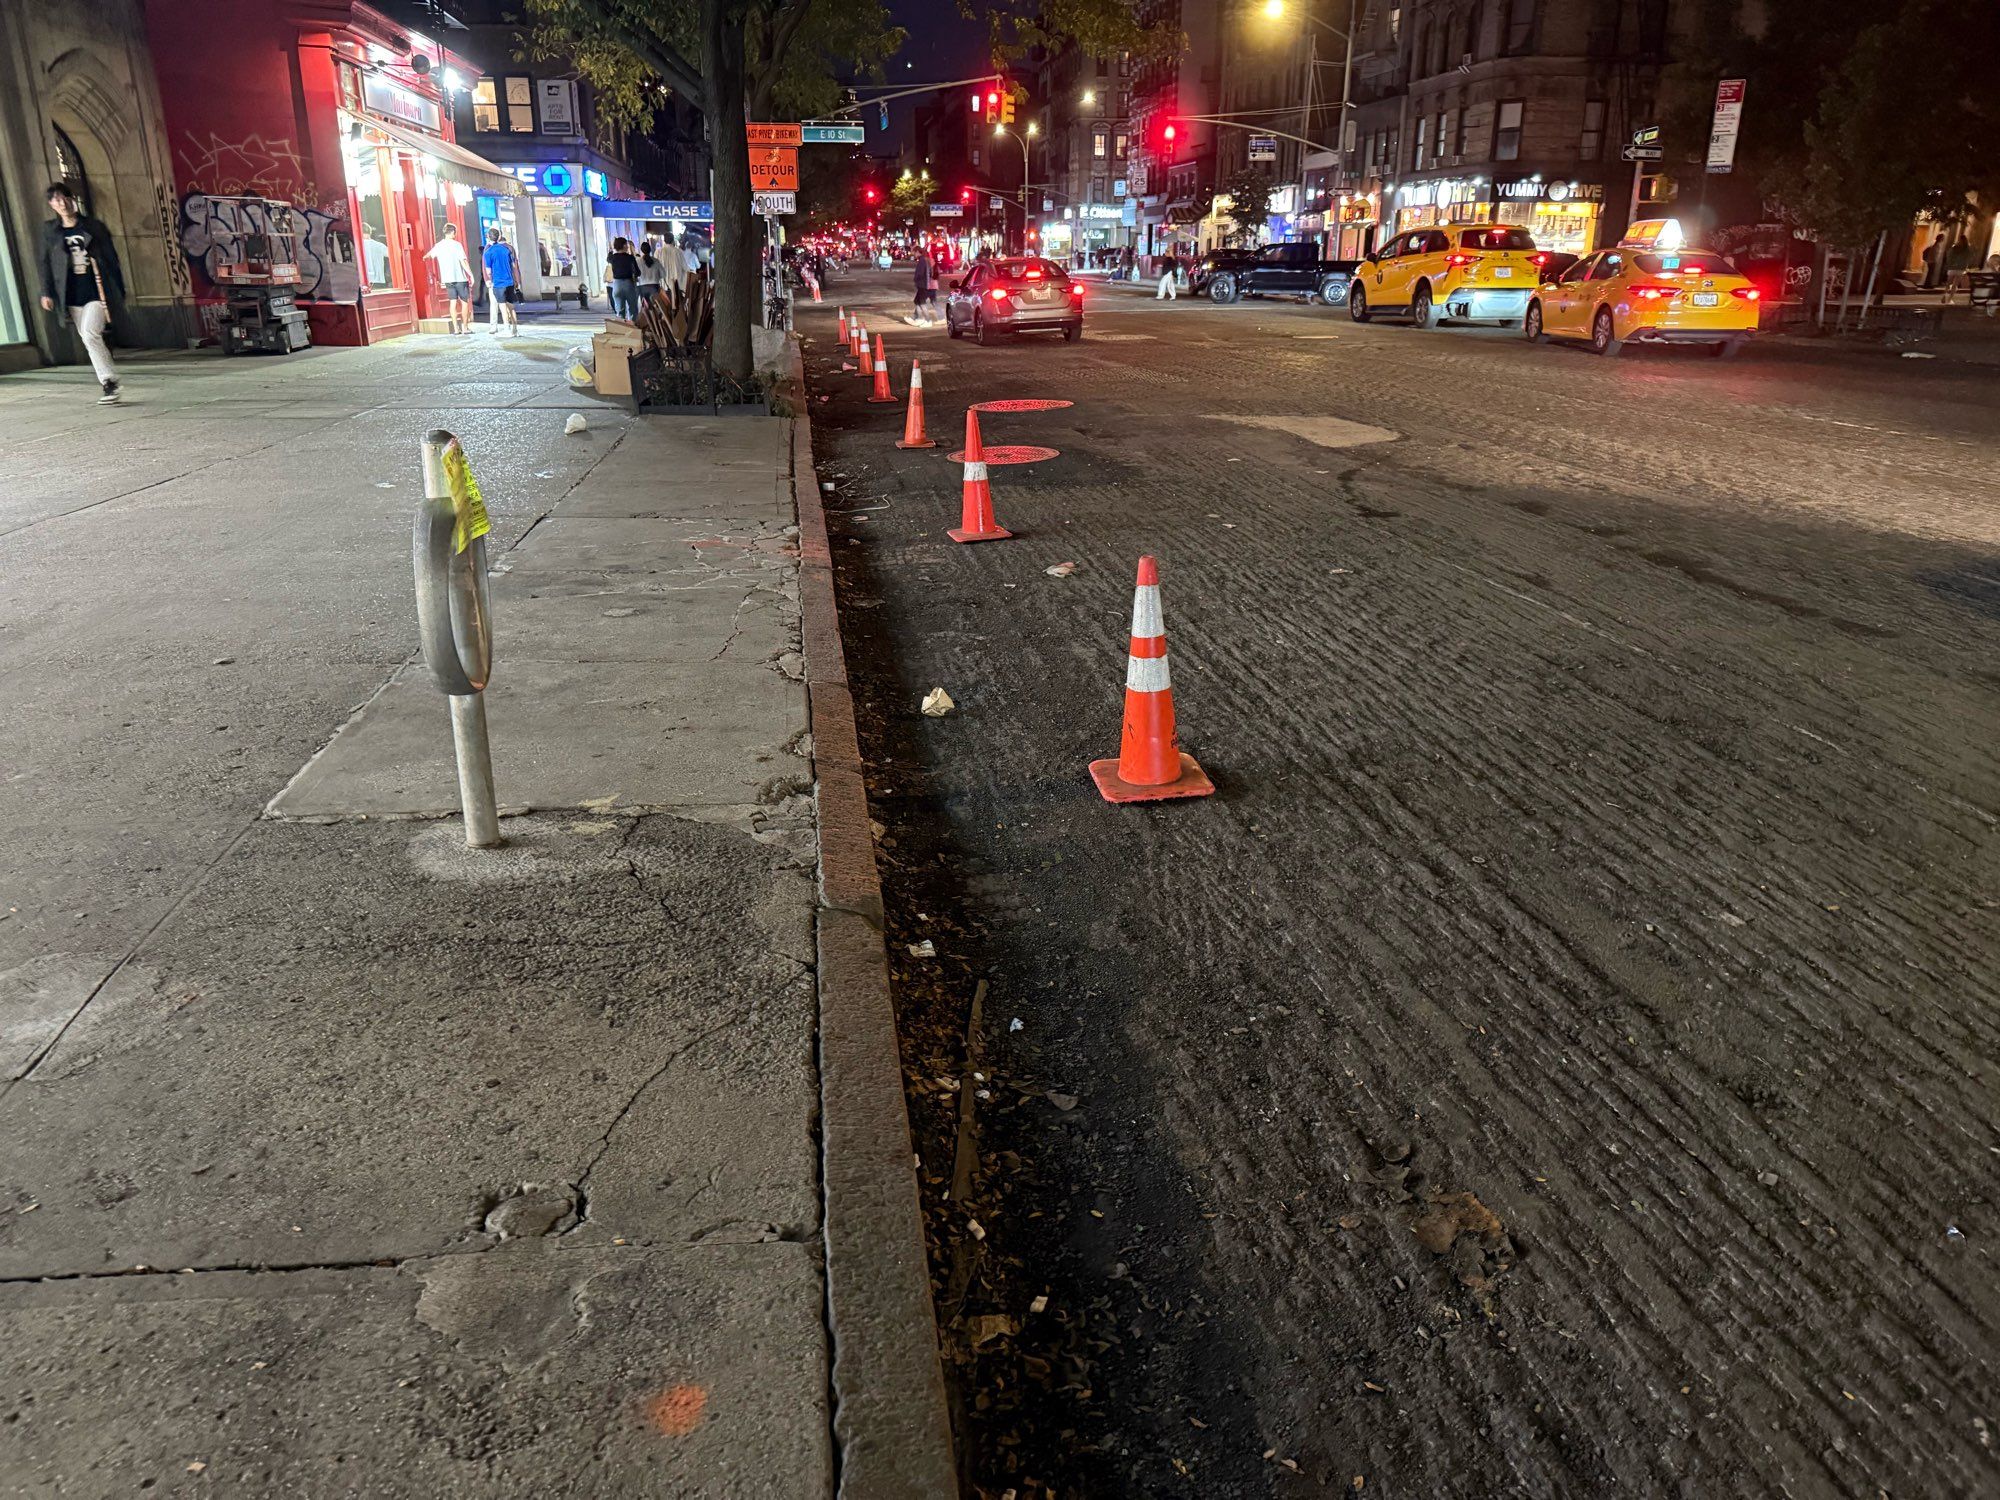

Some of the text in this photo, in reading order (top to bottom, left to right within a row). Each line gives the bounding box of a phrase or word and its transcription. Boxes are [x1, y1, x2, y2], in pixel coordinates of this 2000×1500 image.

[748, 128, 757, 139] AST
[820, 130, 845, 139] E 10 St
[752, 165, 795, 176] DETOUR
[1135, 178, 1145, 186] 25
[1496, 183, 1603, 198] YUMMY HIVE
[652, 205, 699, 217] CHASE
